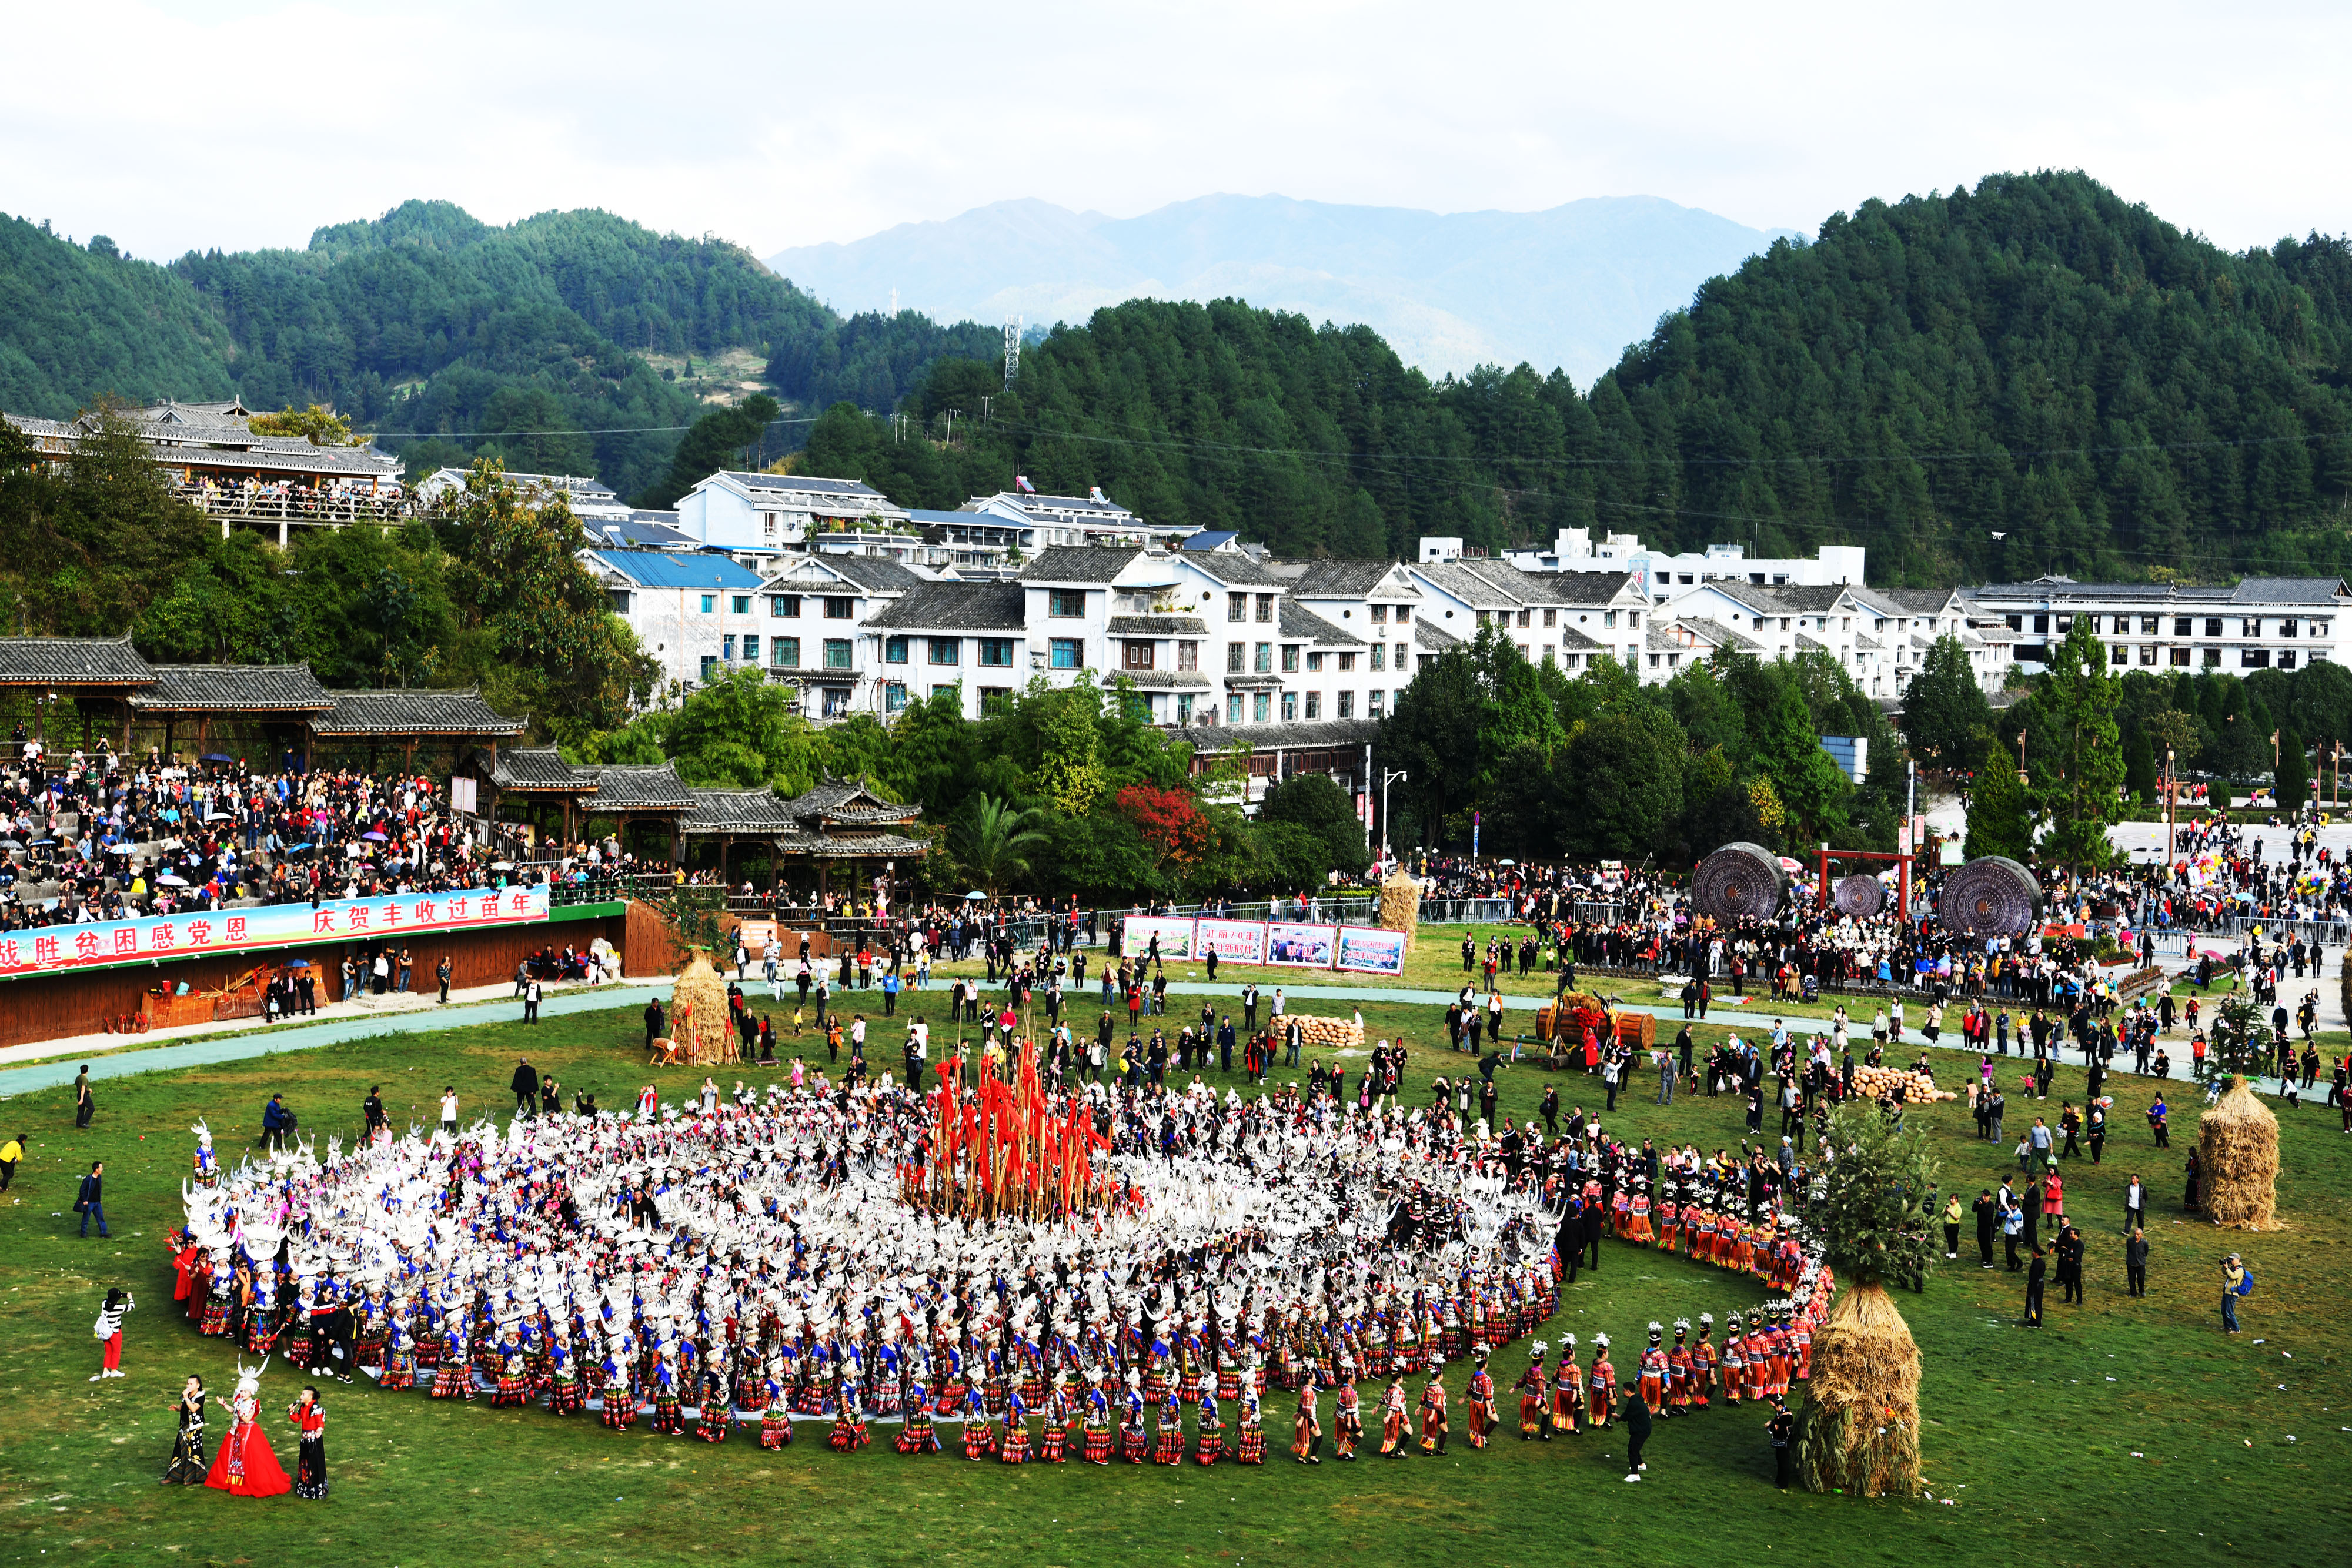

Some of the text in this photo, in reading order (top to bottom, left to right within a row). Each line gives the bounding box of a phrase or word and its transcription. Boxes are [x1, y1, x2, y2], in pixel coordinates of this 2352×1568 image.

[0, 893, 530, 966] 战胜贫困感党恩 庆贺丰收过苗年
[1207, 928, 1255, 941] 壮丽70年
